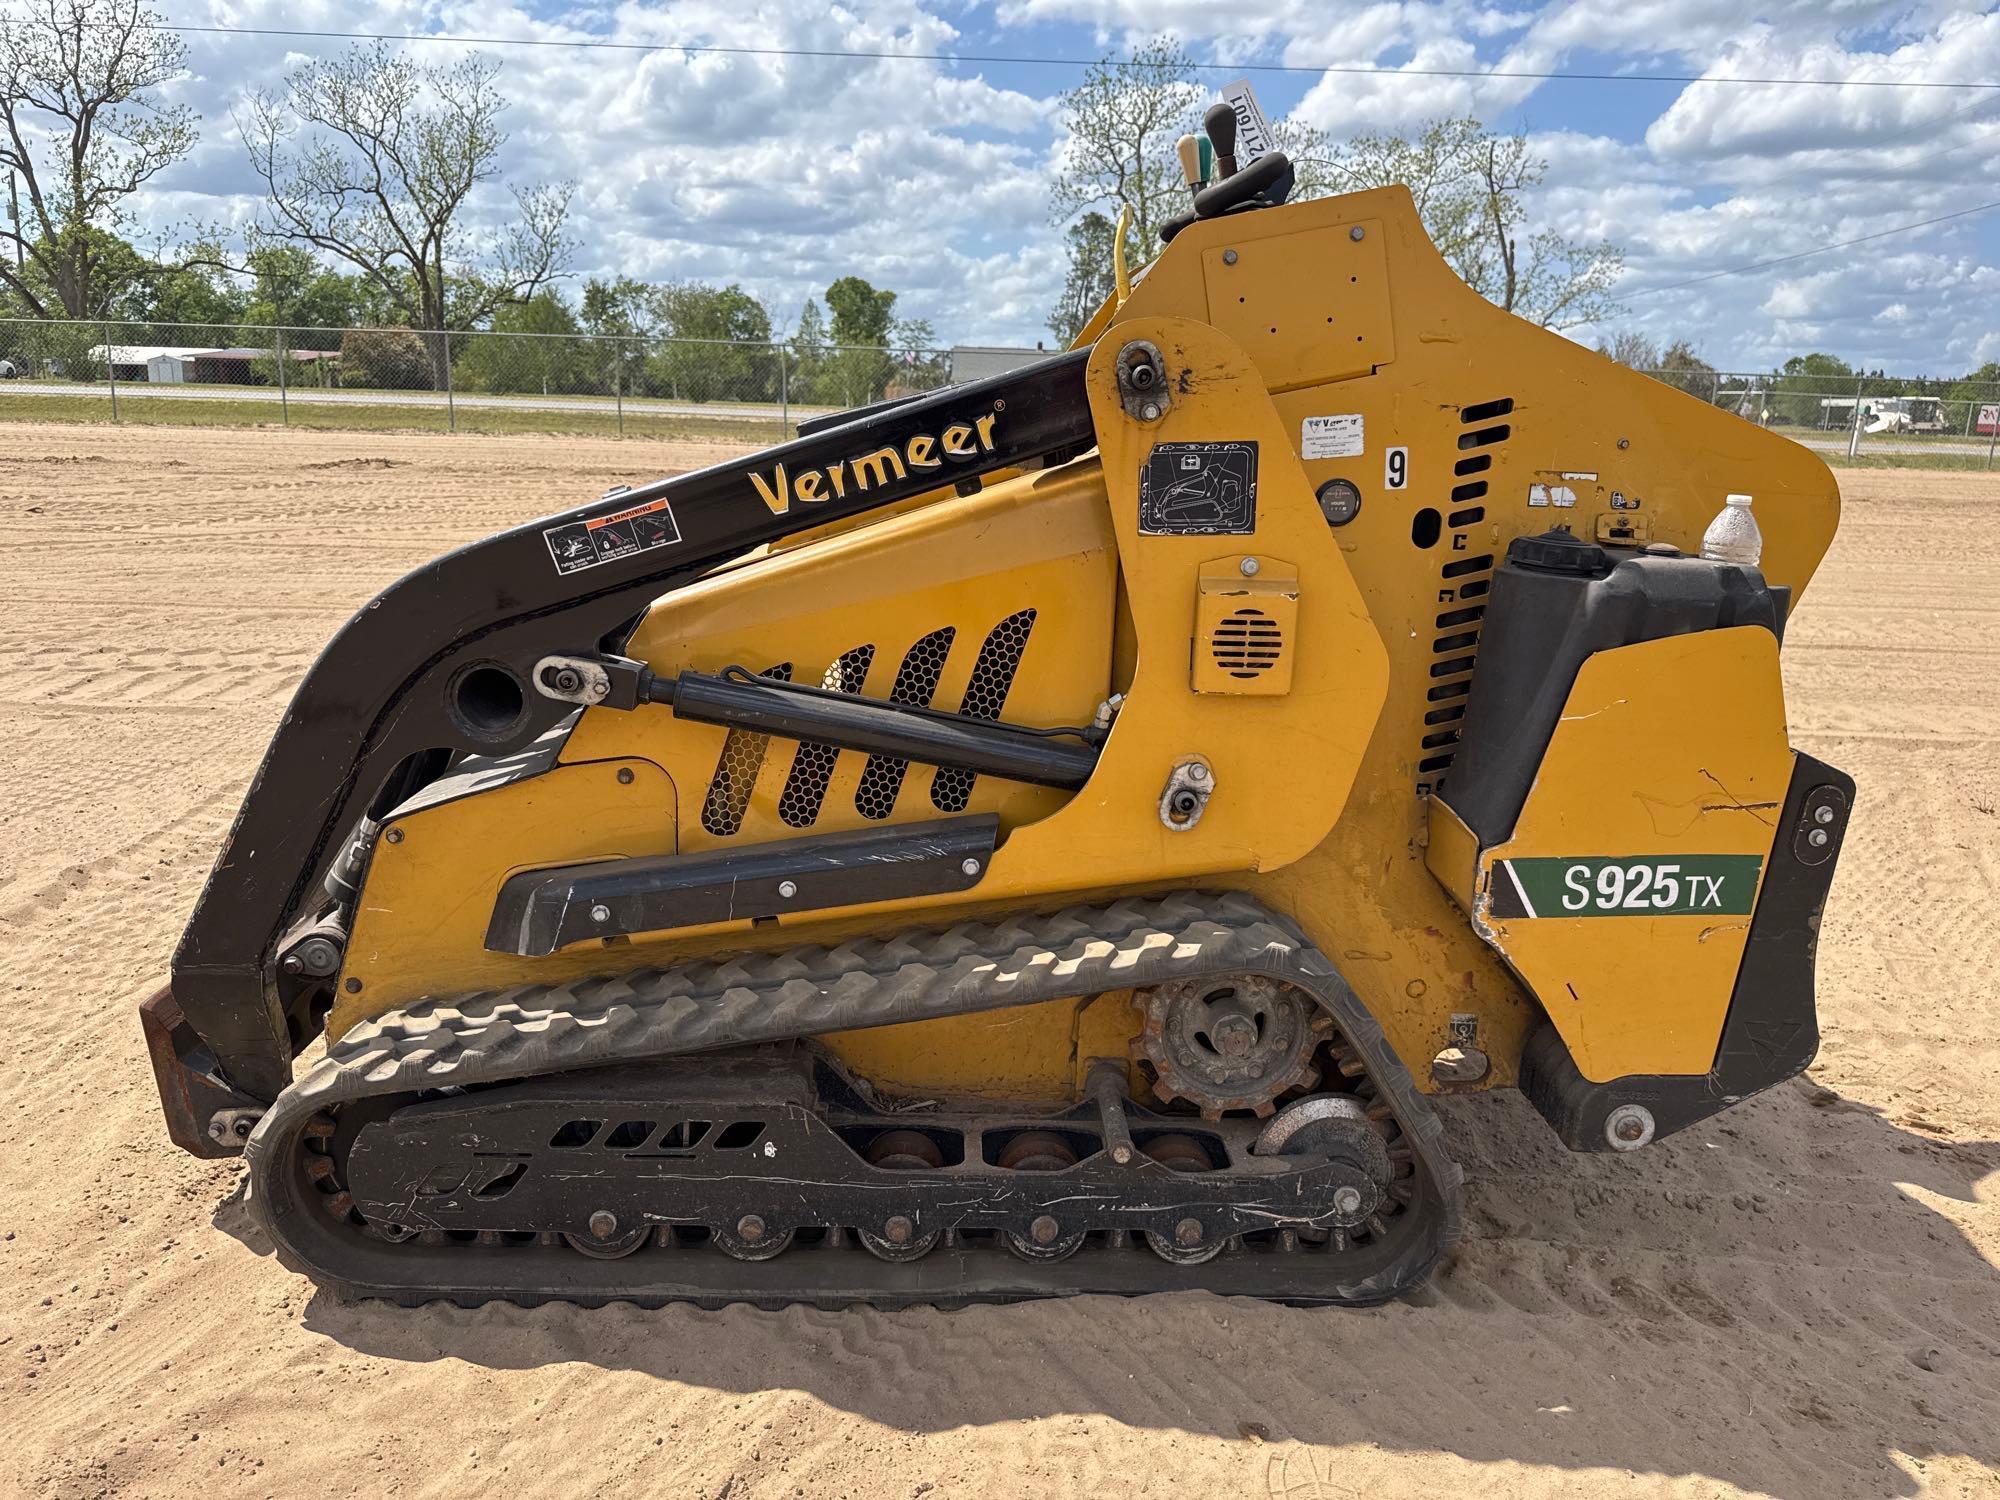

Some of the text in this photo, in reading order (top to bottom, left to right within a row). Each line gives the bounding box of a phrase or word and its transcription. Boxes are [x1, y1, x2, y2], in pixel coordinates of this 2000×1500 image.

[1230, 96, 1265, 157] 217601
[748, 412, 996, 515] Vermeer
[1389, 450, 1405, 488] 9
